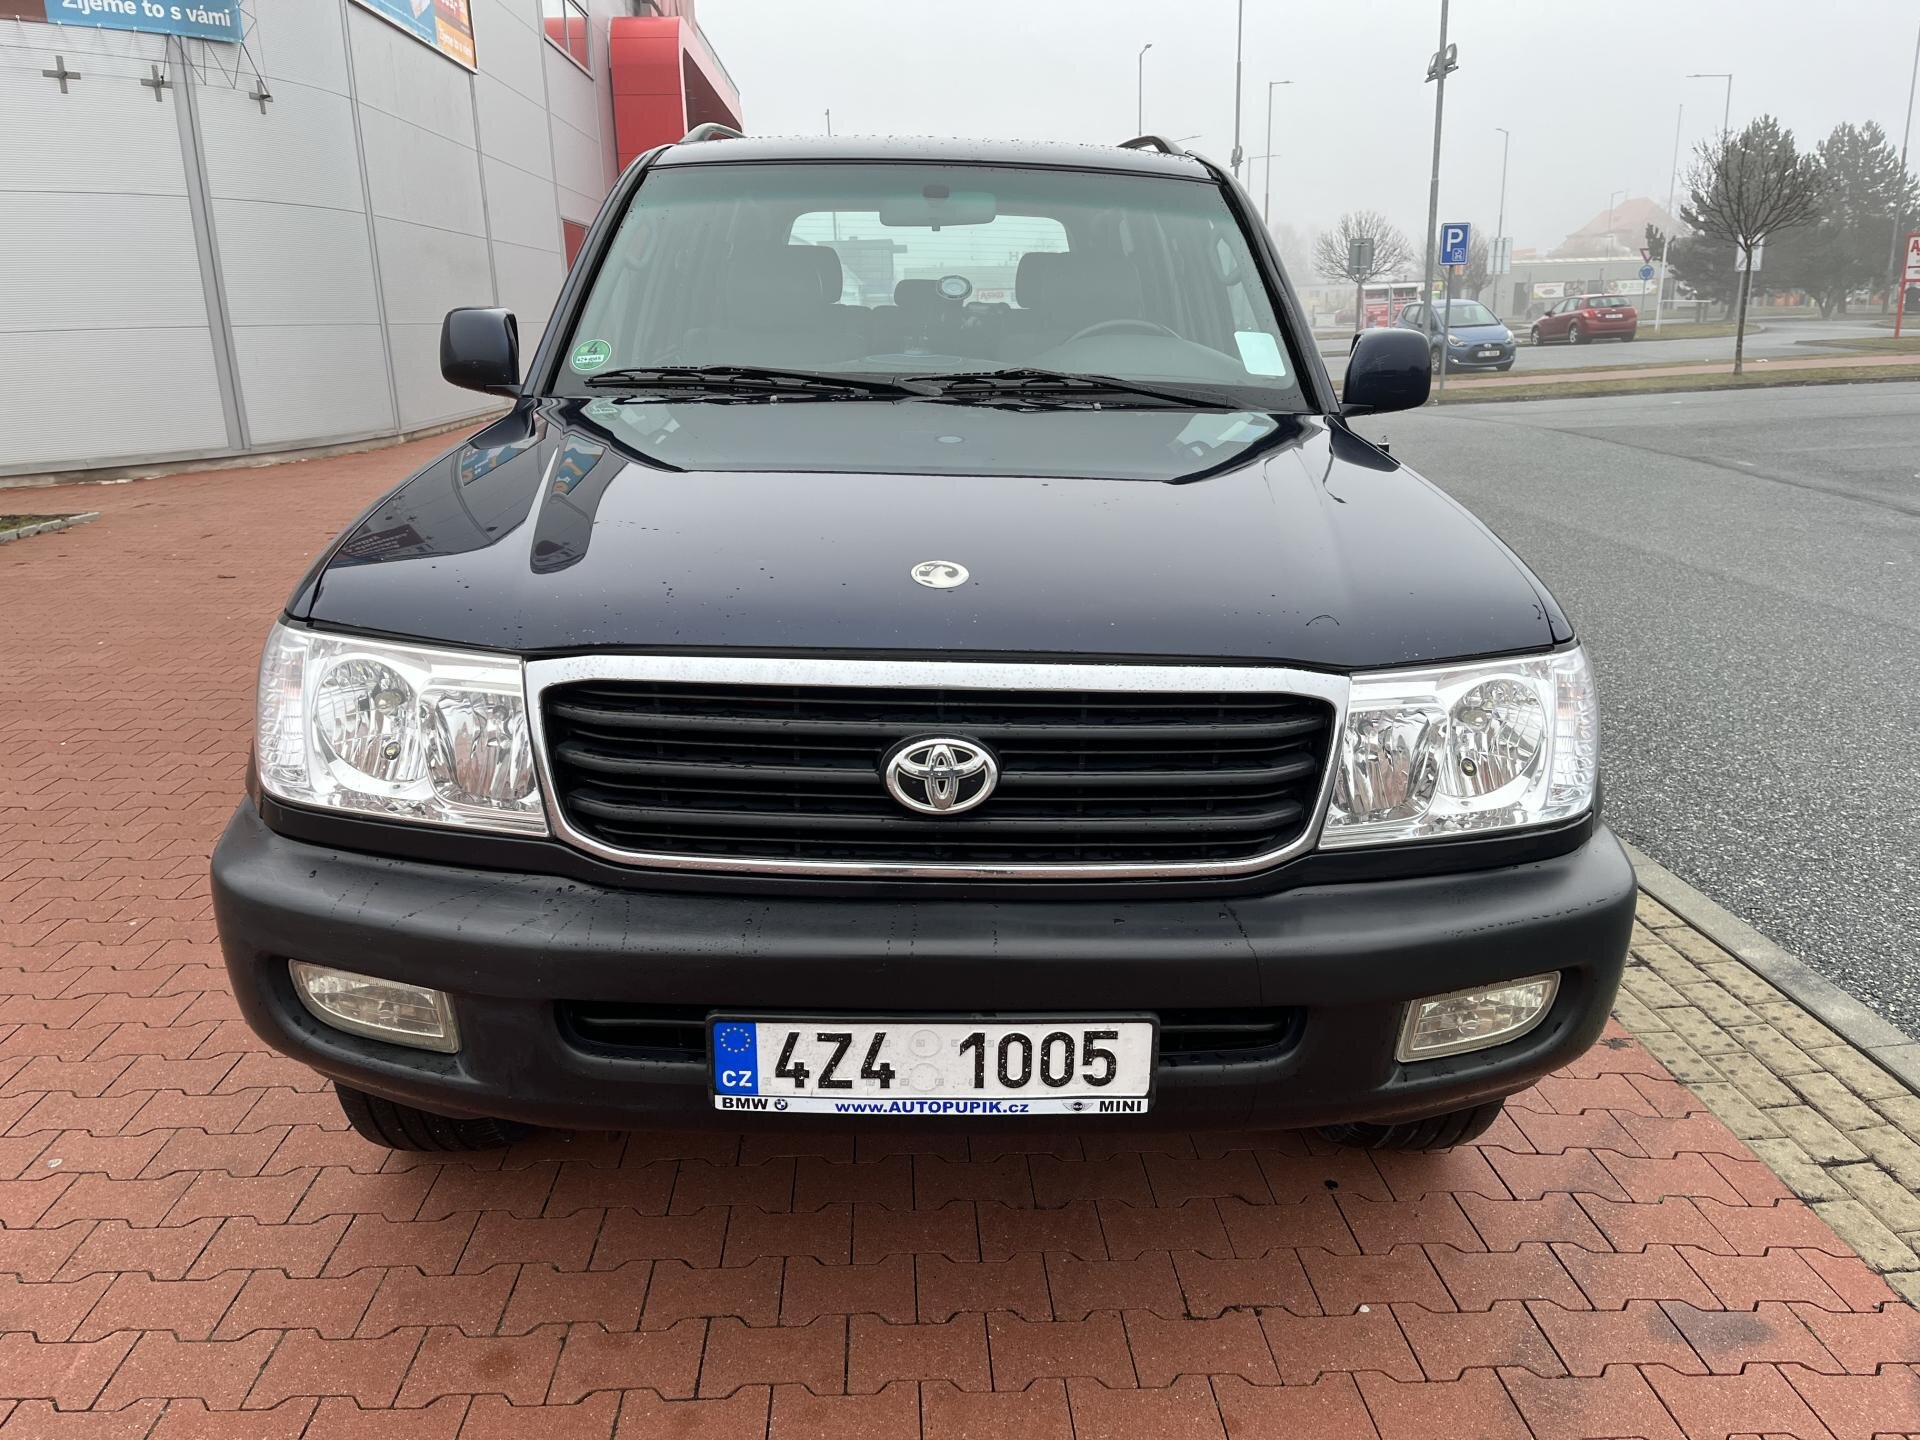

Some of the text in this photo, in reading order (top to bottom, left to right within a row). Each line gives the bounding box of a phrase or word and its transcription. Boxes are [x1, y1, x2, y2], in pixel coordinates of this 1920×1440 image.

[141, 0, 165, 18] to
[170, 6, 182, 20] s
[185, 5, 231, 27] vámi
[1447, 228, 1464, 252] P
[775, 1030, 1119, 1089] 4Z4 1005
[722, 1070, 752, 1087] CZ
[721, 1096, 1142, 1114] BMW www.AUTOPUPIK.cz MINI
